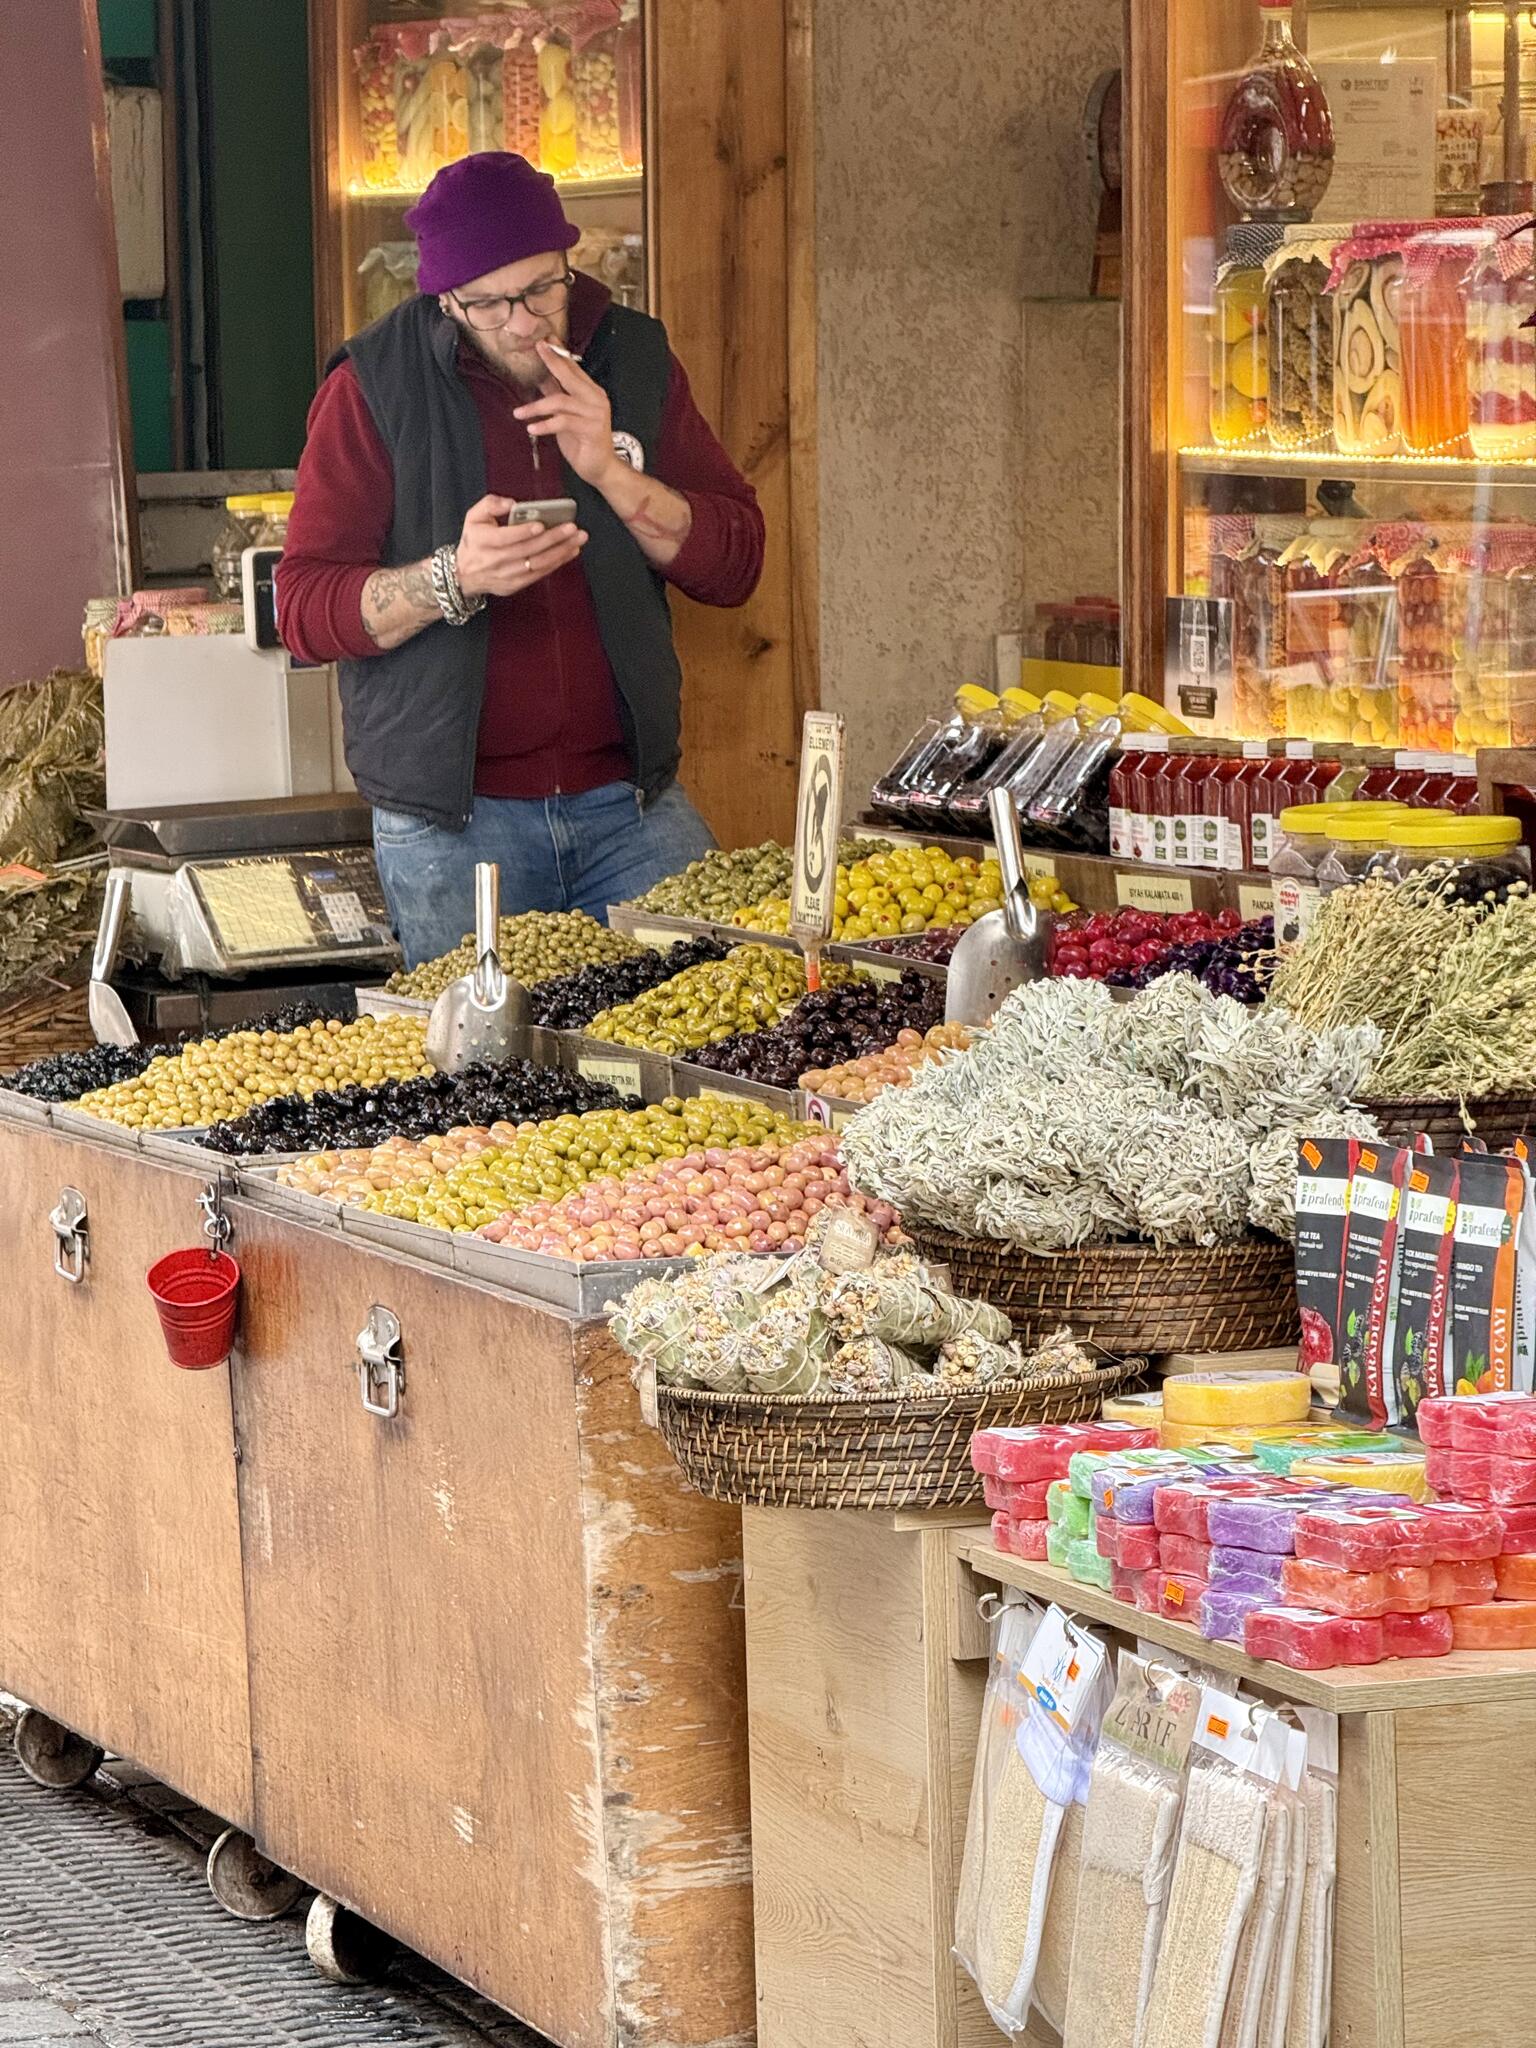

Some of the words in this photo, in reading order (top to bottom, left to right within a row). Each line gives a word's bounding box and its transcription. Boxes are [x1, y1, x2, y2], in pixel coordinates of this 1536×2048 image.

[345, 855, 369, 865] CAS
[1366, 1306, 1381, 1397] KARADUT
[1426, 1319, 1440, 1398] ARADUT
